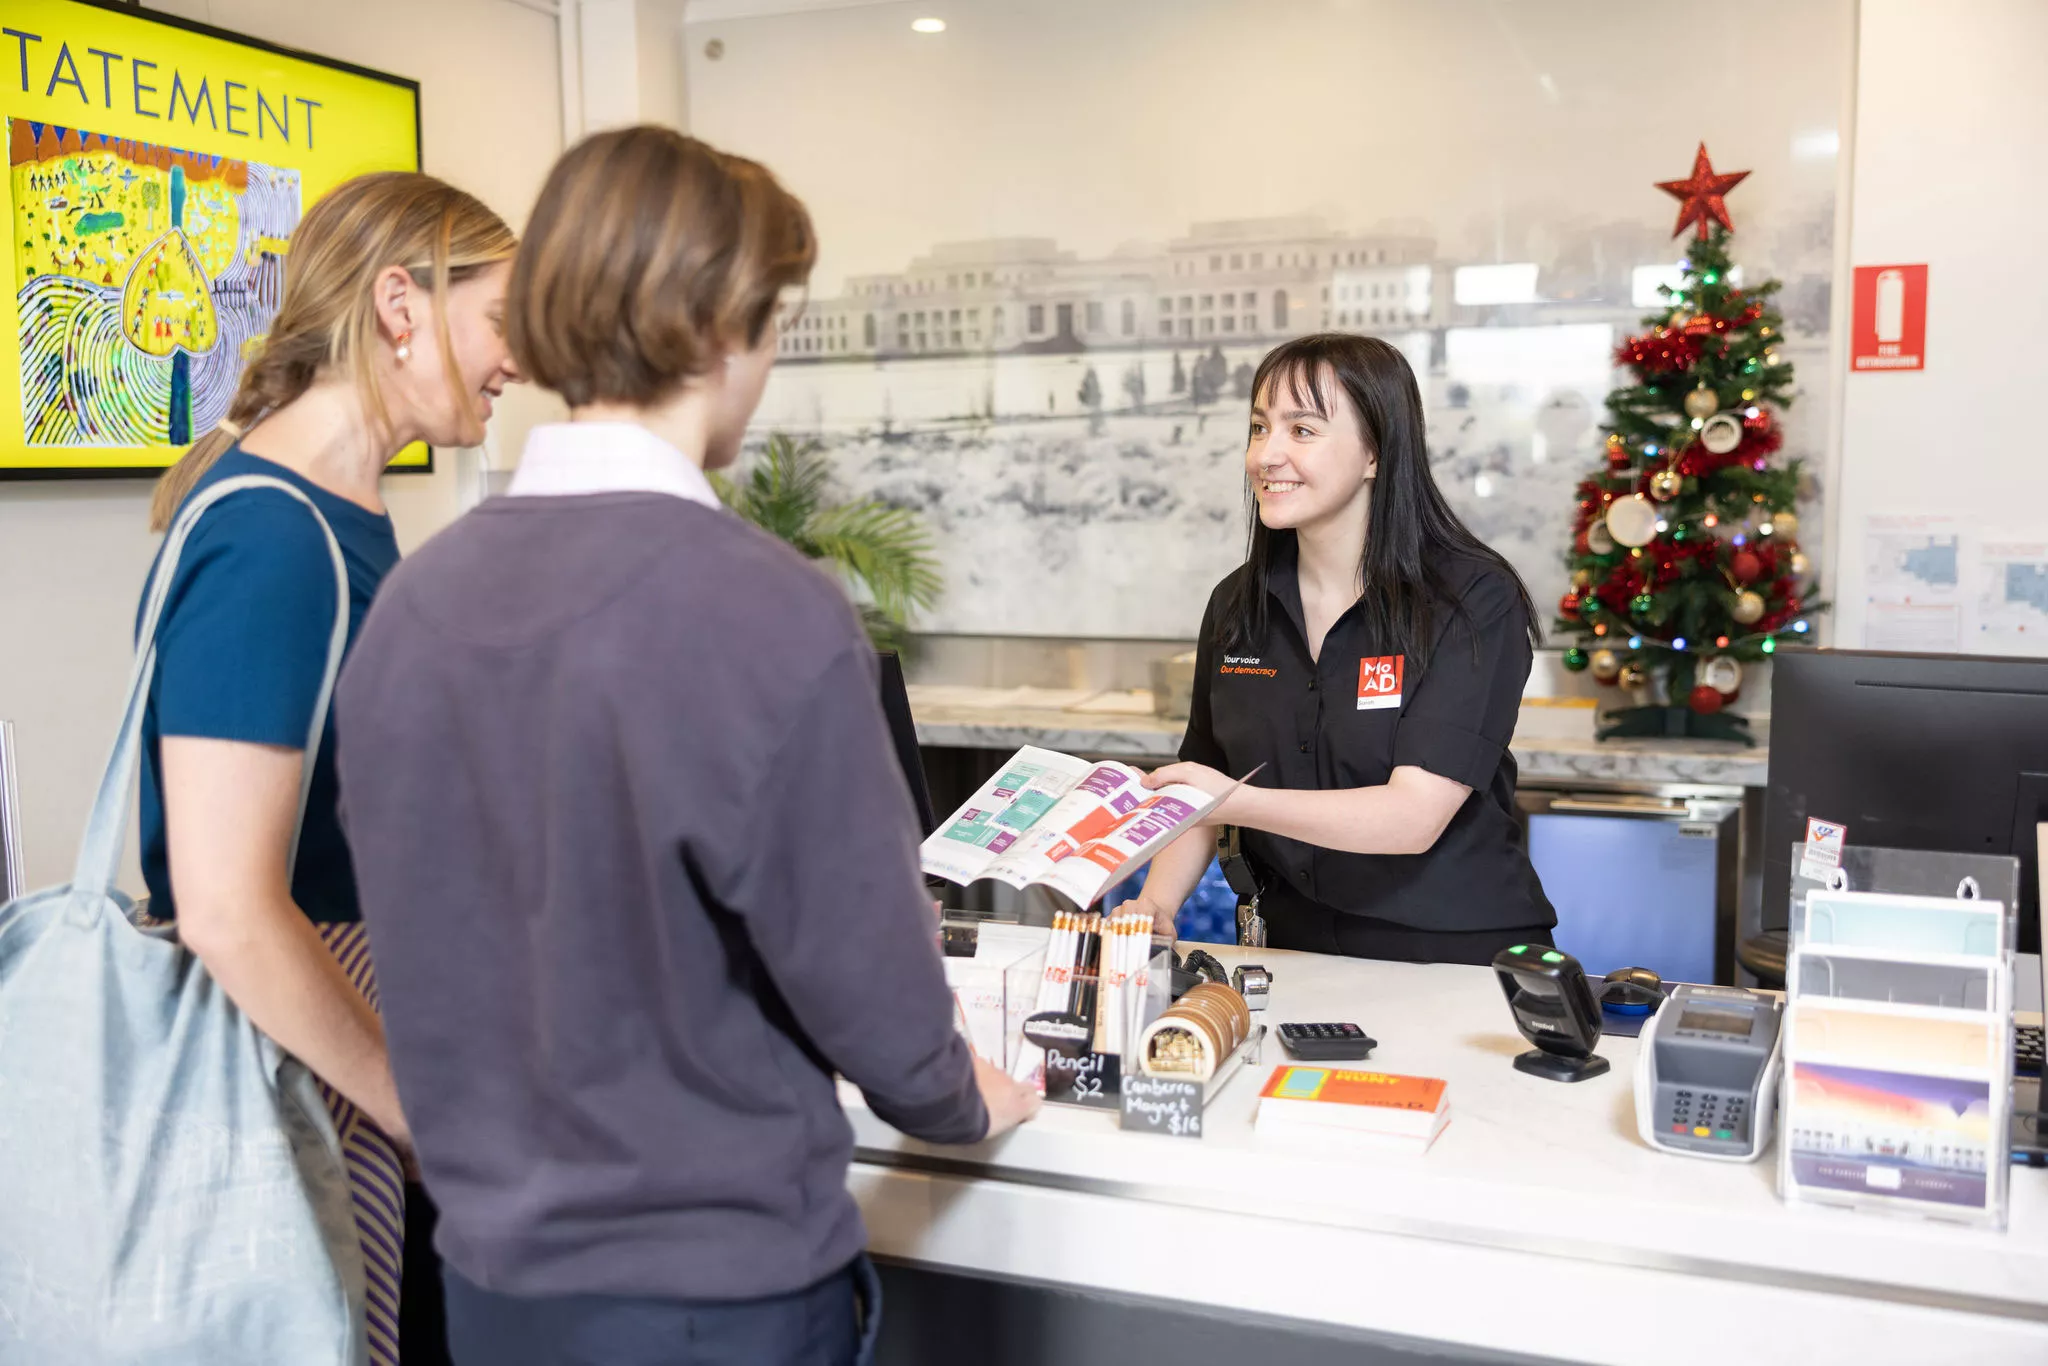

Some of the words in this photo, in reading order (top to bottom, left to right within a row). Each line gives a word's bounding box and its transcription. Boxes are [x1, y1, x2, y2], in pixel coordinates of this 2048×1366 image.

[2, 27, 323, 149] TATEMENT
[1223, 654, 1240, 663] Your
[1240, 655, 1261, 665] voice
[1364, 661, 1392, 676] Mo
[1220, 665, 1234, 674] Our
[1234, 665, 1278, 678] democracy
[1363, 674, 1397, 693] AD
[1047, 1048, 1105, 1072] Pencil
[1072, 1069, 1105, 1101] $2
[1122, 1075, 1196, 1097] Canberra
[1126, 1097, 1190, 1126] Magnet
[1167, 1111, 1201, 1135] $16
